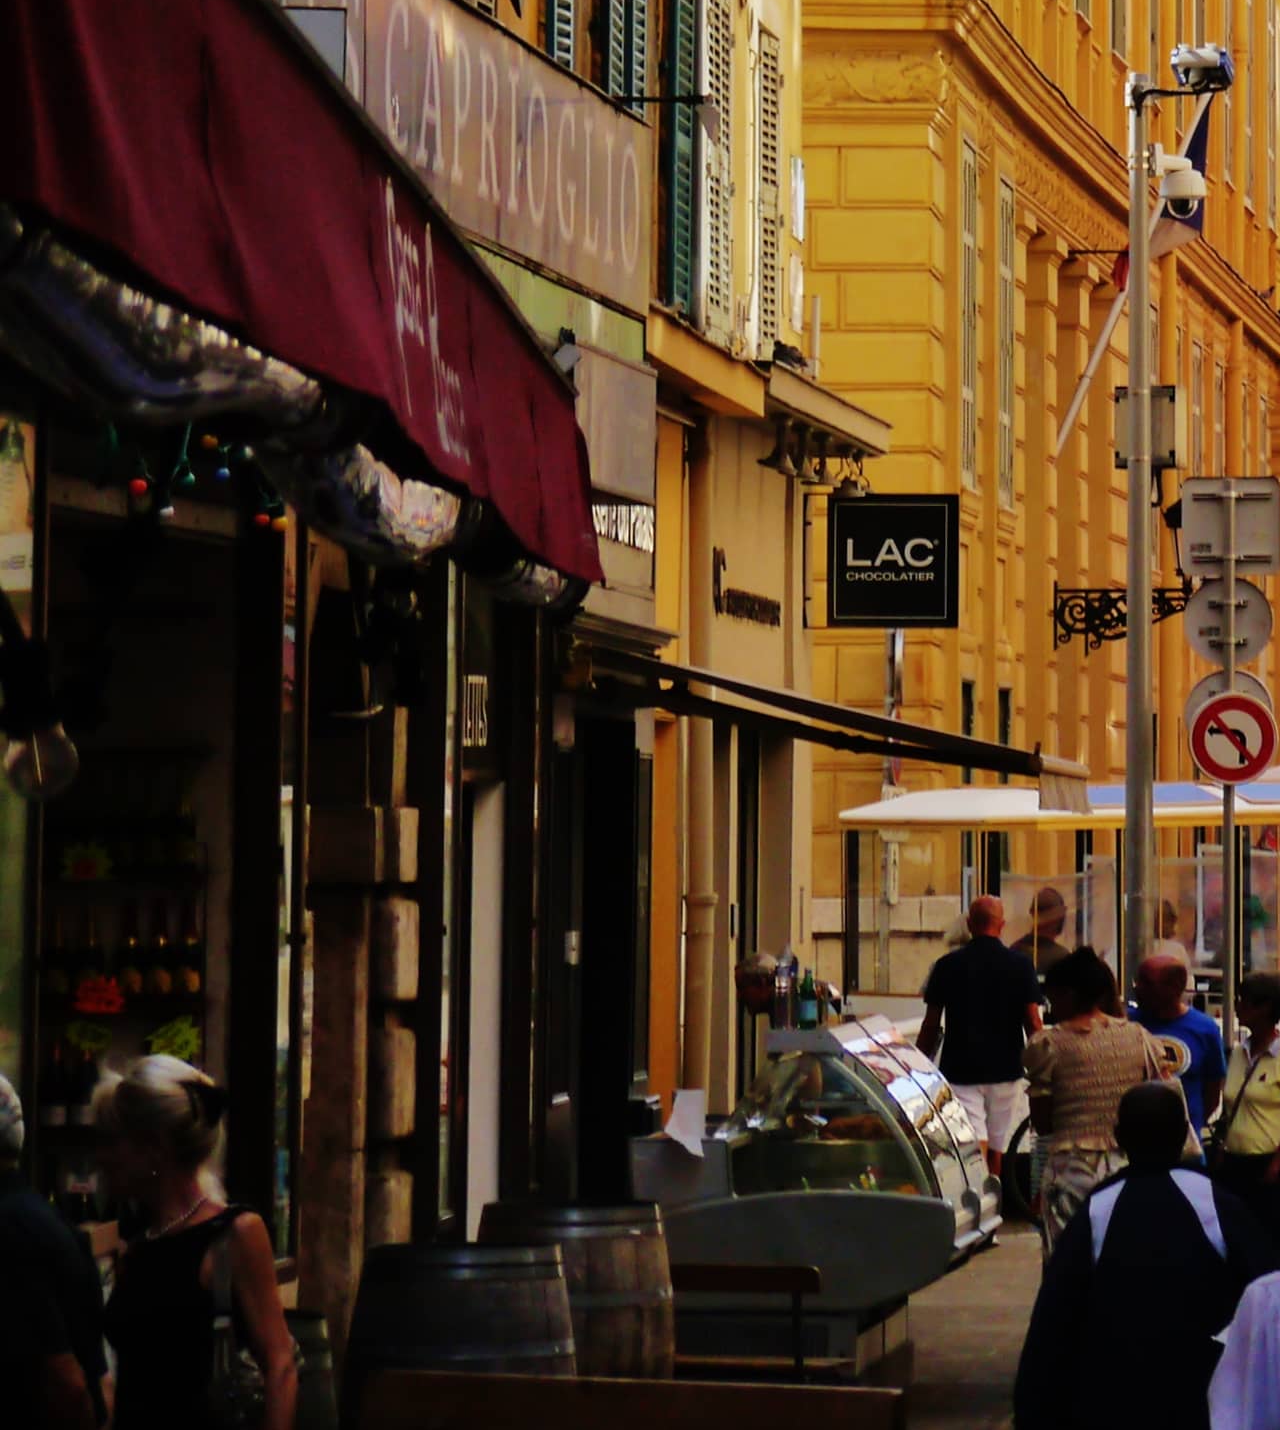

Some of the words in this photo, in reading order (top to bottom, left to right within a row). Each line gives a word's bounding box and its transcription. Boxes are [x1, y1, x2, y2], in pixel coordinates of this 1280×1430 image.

[385, 0, 640, 275] CAPRIOGLIO
[846, 537, 934, 568] LAC
[846, 571, 935, 582] CHOCOLATIER
